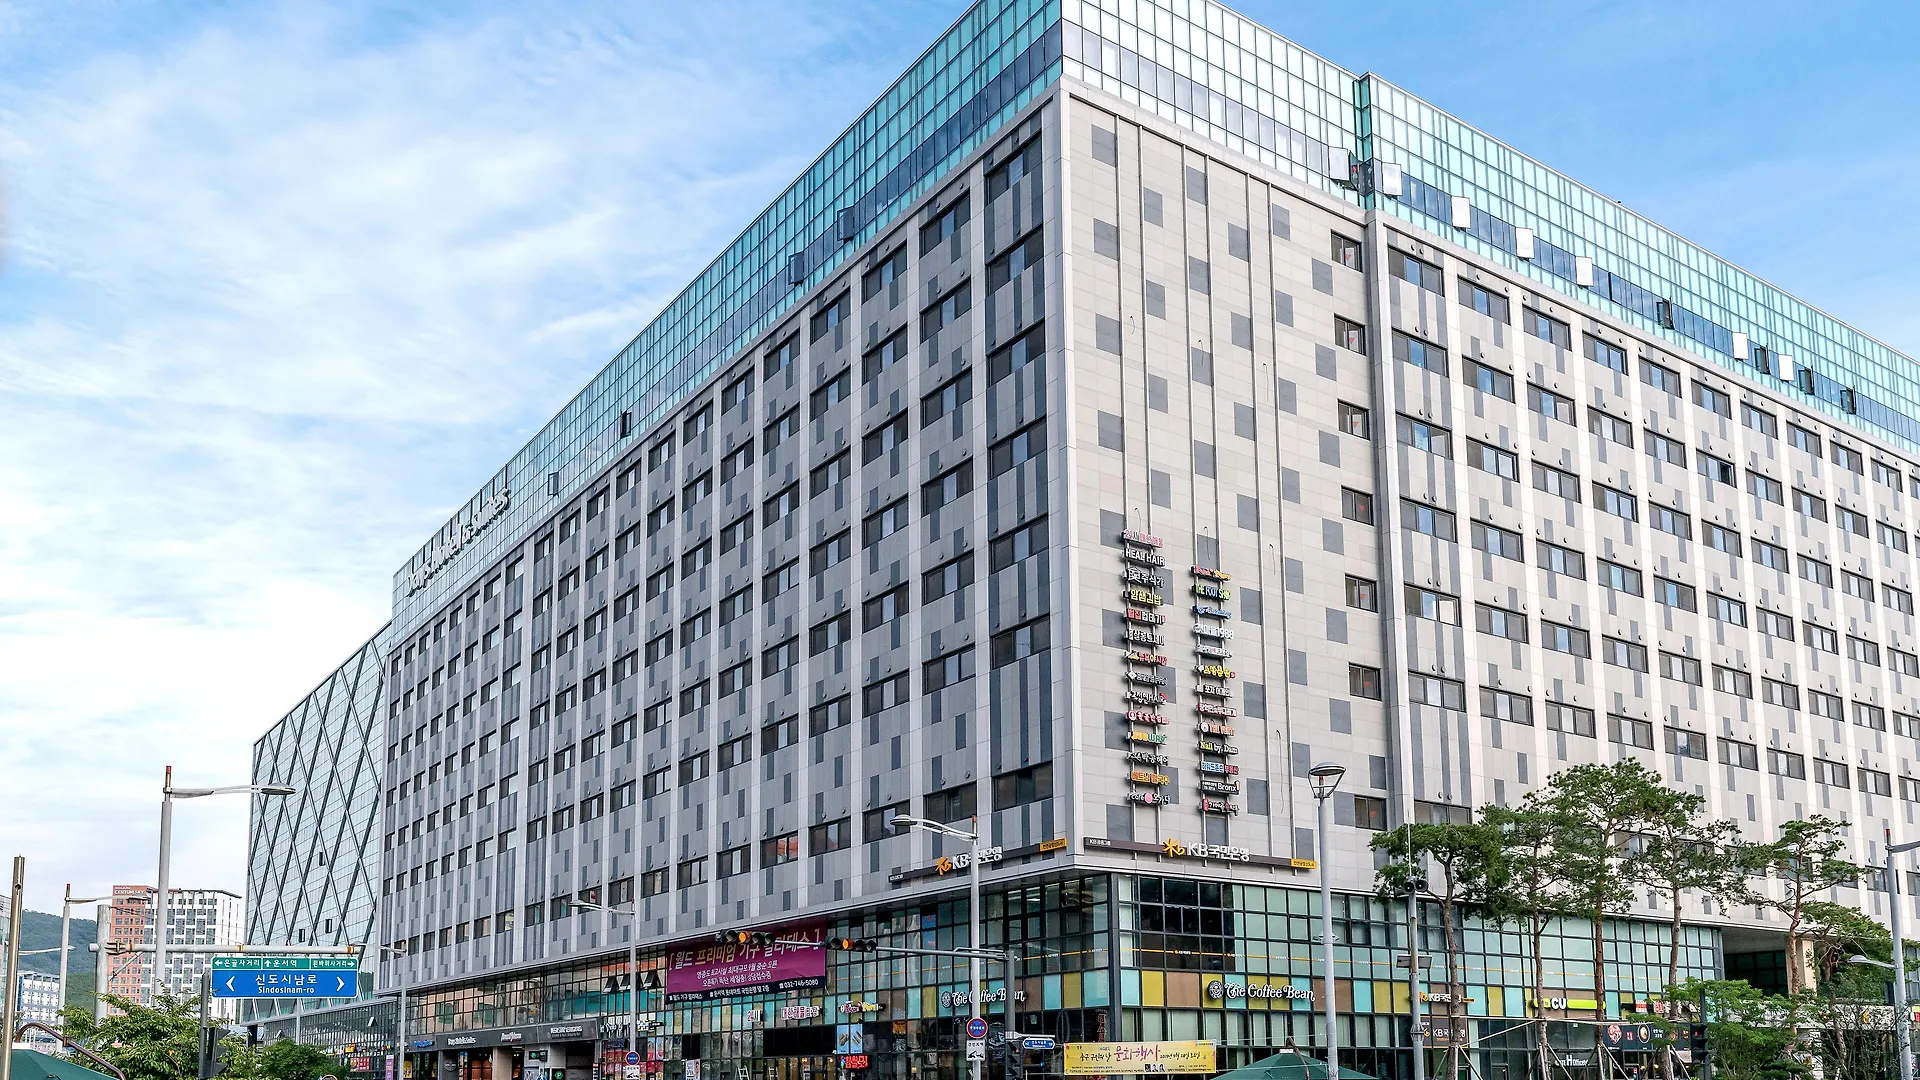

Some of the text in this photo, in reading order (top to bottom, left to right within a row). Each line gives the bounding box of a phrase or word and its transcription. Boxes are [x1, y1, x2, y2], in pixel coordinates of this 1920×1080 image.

[1126, 548, 1165, 566] HEAL HAIR
[1218, 783, 1236, 792] Bronx
[1187, 842, 1250, 862] KB국민은행
[273, 959, 297, 968] 운서역
[675, 951, 693, 969] 월드
[695, 944, 737, 965] 프리미엄
[255, 974, 318, 986] 신도시남로
[258, 986, 315, 994] Sindosinam-ro
[952, 991, 967, 1006] The
[969, 989, 996, 1003] Cffee
[1224, 983, 1316, 1002] The Coffee Bean
[1551, 997, 1566, 1009] CU
[1114, 1045, 1160, 1061] 문화행사
